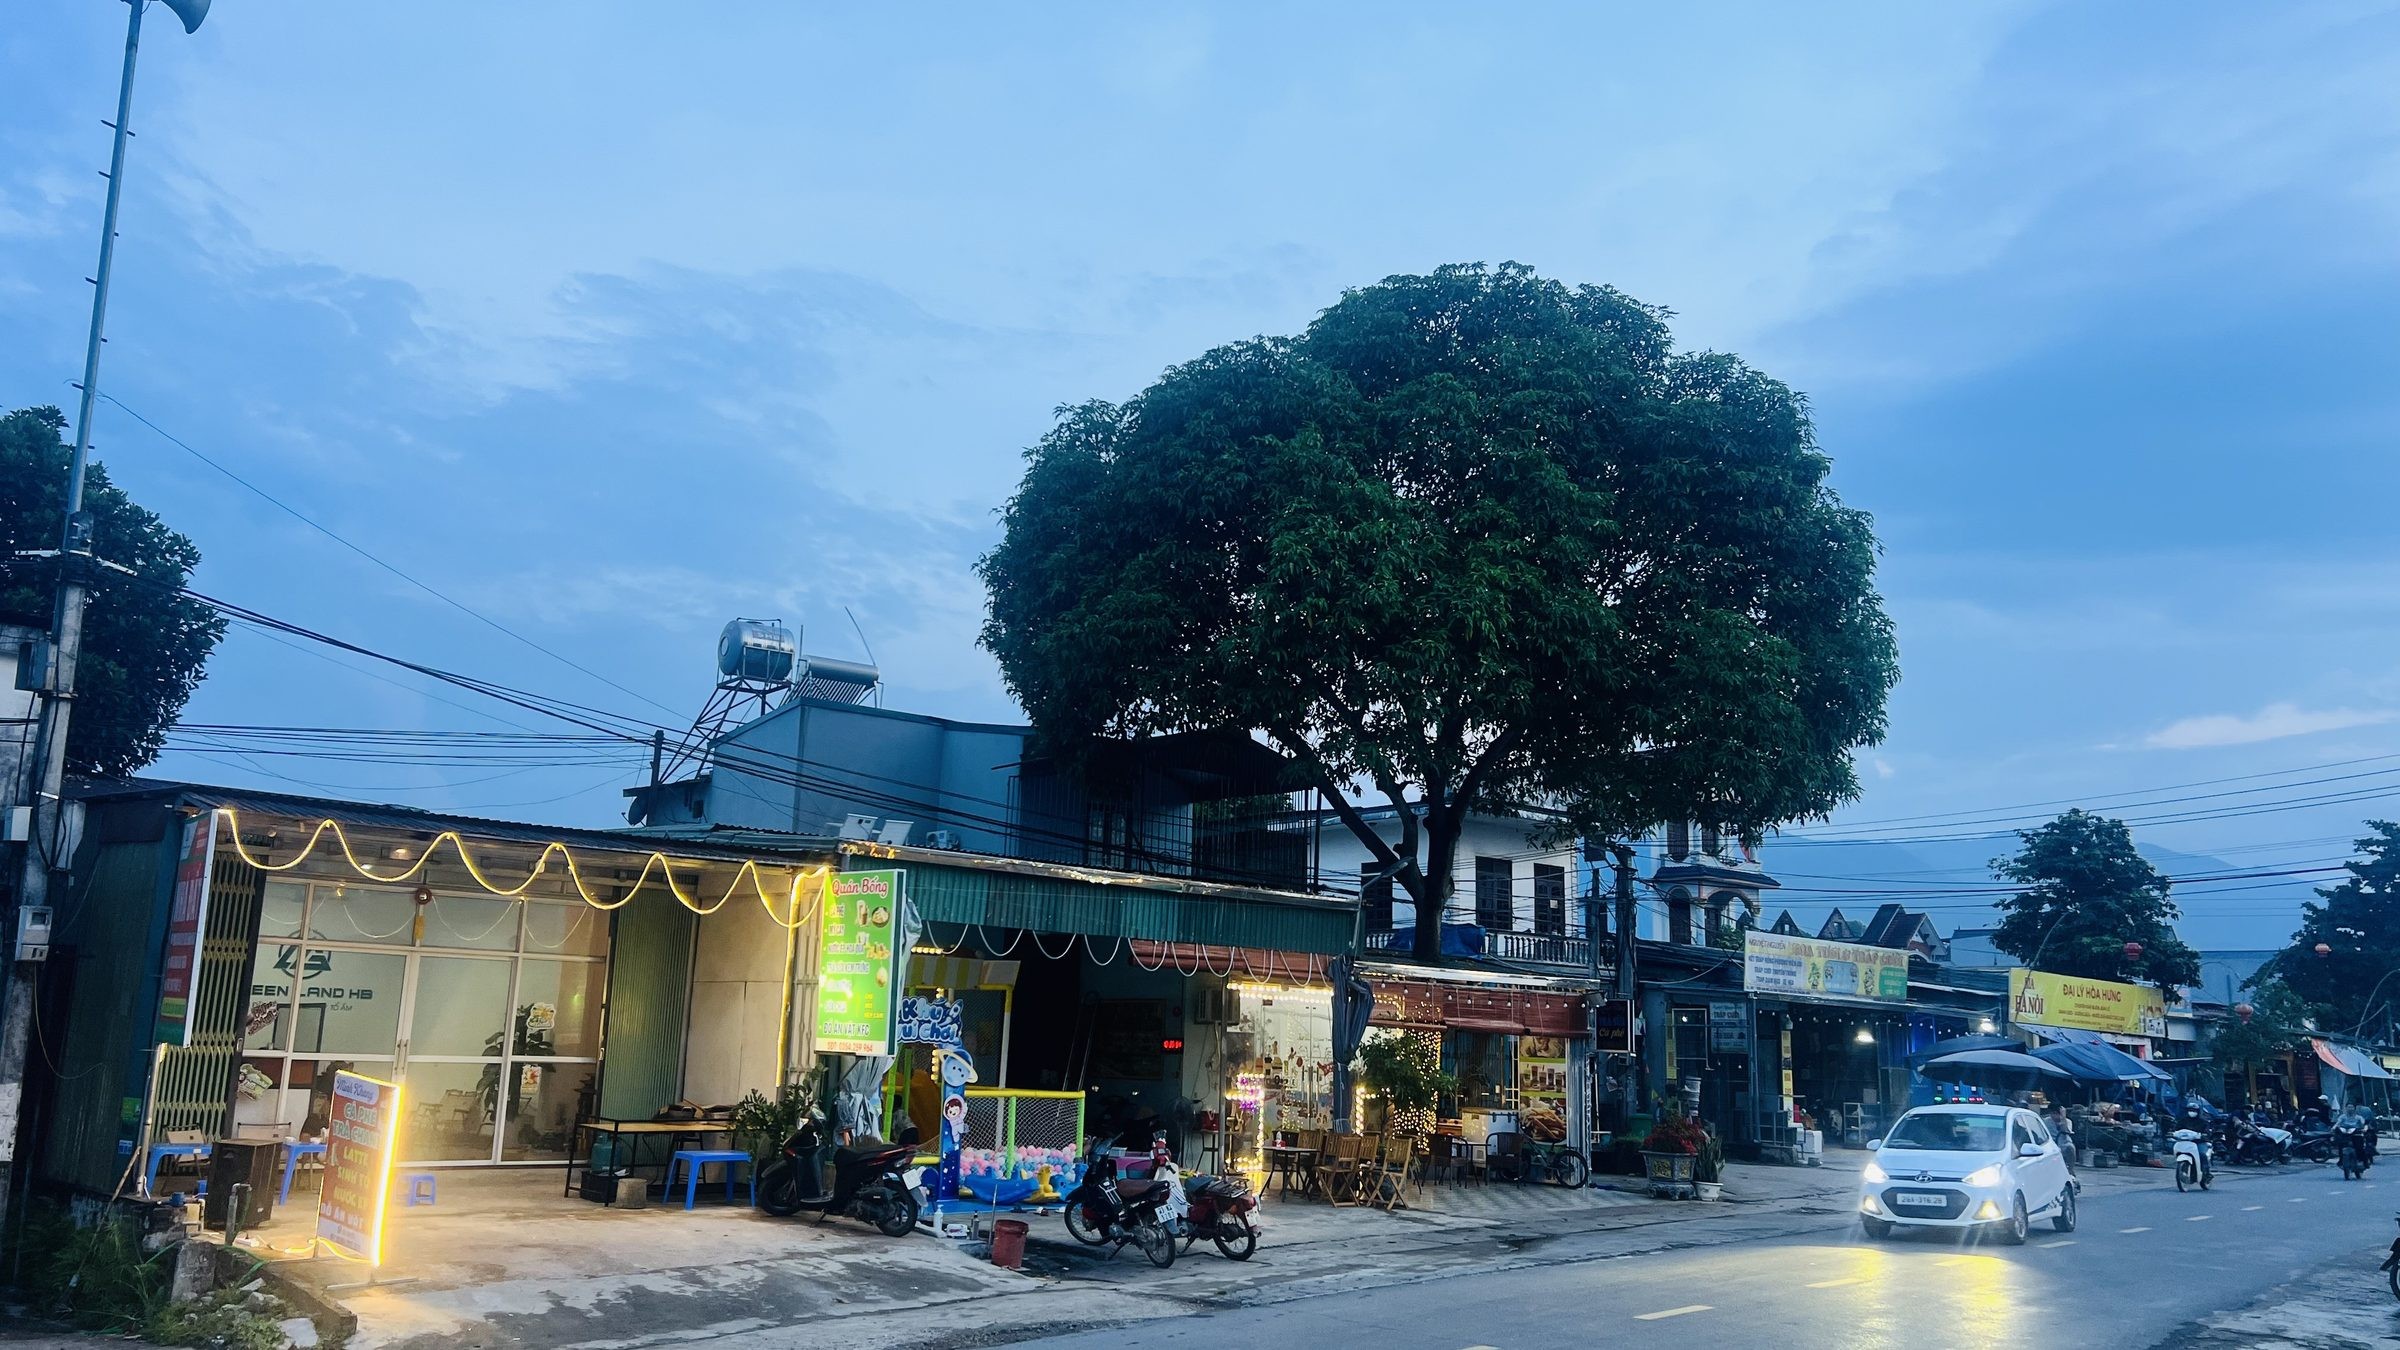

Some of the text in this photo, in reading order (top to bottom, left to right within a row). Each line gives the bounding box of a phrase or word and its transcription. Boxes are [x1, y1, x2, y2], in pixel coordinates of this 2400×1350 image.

[832, 876, 888, 898] Quán Bống
[349, 989, 373, 999] HB
[857, 1024, 870, 1036] KFC
